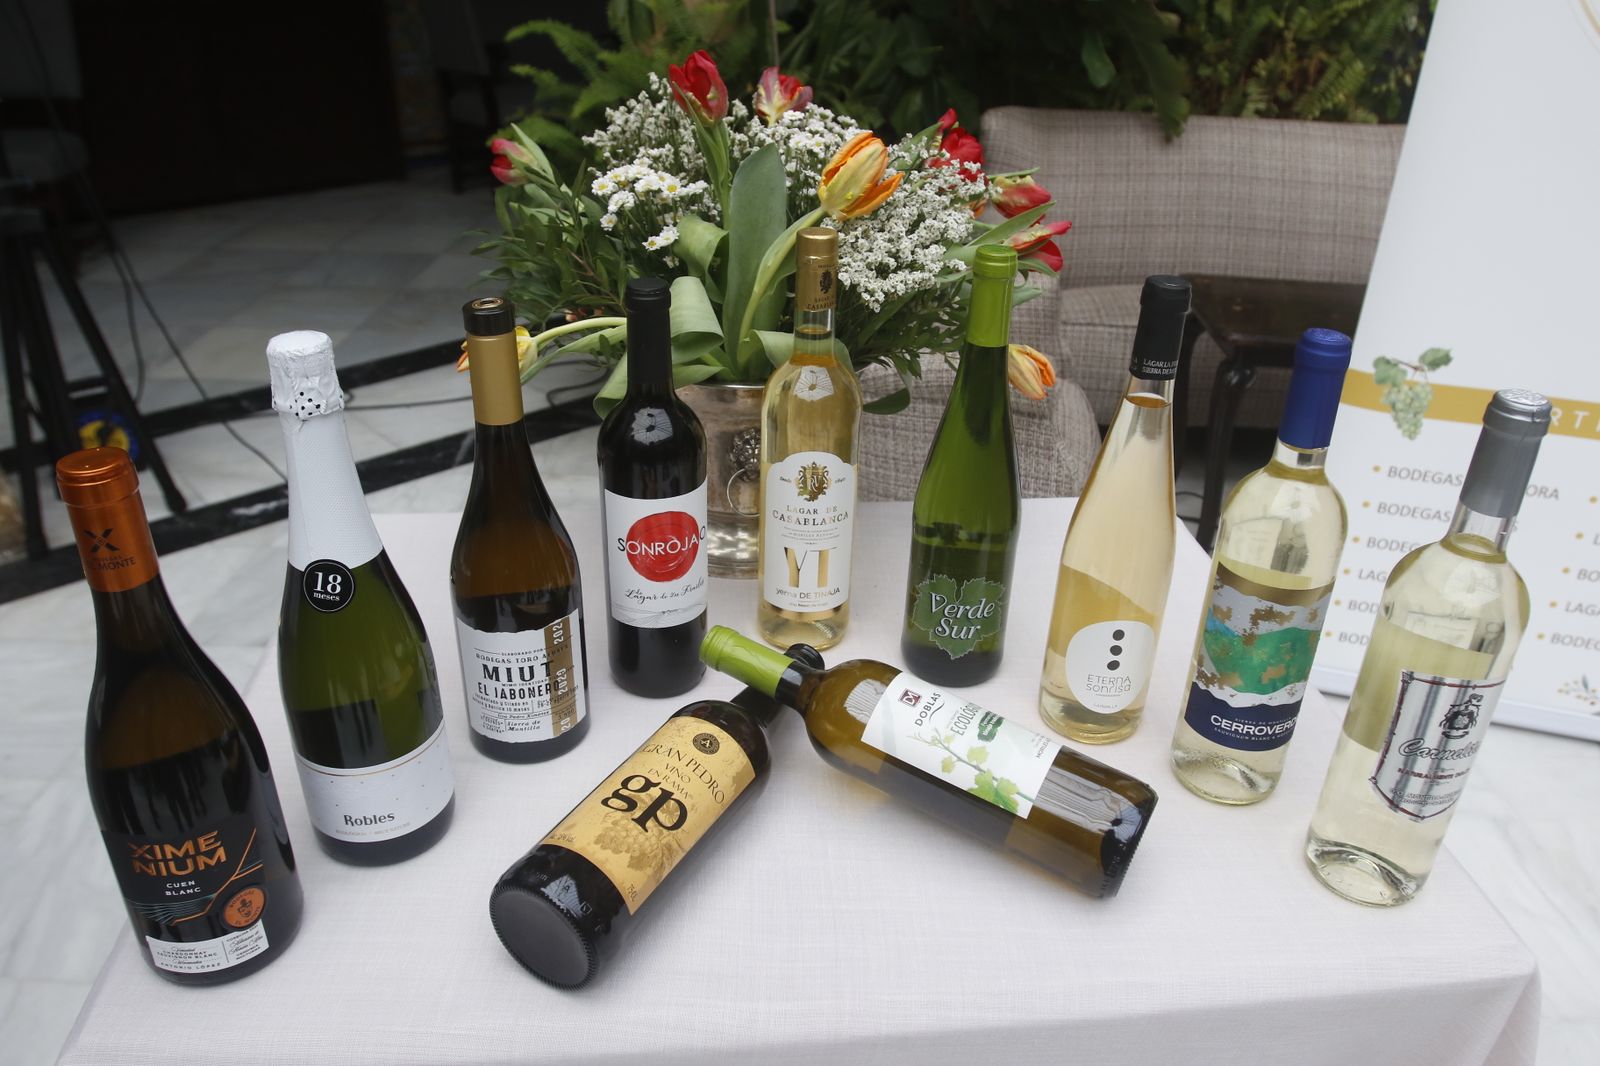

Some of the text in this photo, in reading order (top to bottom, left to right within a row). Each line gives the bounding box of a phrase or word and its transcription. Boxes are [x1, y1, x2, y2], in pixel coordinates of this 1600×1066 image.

[1387, 465, 1464, 487] BODEGAS
[772, 510, 849, 526] CASABLANCA
[786, 505, 838, 515] LAGAR DE
[1377, 501, 1451, 523] BODEGAS
[312, 571, 342, 594] 18
[776, 588, 797, 598] yema
[814, 587, 840, 599] TINAJA
[313, 591, 340, 602] meses
[930, 591, 995, 619] Verde
[935, 617, 981, 639] Sur
[475, 653, 512, 664] BODEGAS
[515, 655, 539, 664] TORO
[477, 682, 489, 697] EL
[914, 692, 941, 727] DOBLAS
[1213, 727, 1249, 740] SAUVIGNON
[642, 743, 687, 762] GRAN
[685, 758, 724, 804] PEDRO
[648, 768, 690, 799] EN RAMA
[665, 762, 691, 784] VINO
[600, 774, 688, 833] gp
[343, 812, 395, 828] Robles
[127, 830, 222, 860] XIME
[131, 846, 227, 877] NIUM
[165, 887, 201, 896] BLANC
[160, 962, 192, 970] ANTONIO
[195, 952, 218, 960] BLANC
